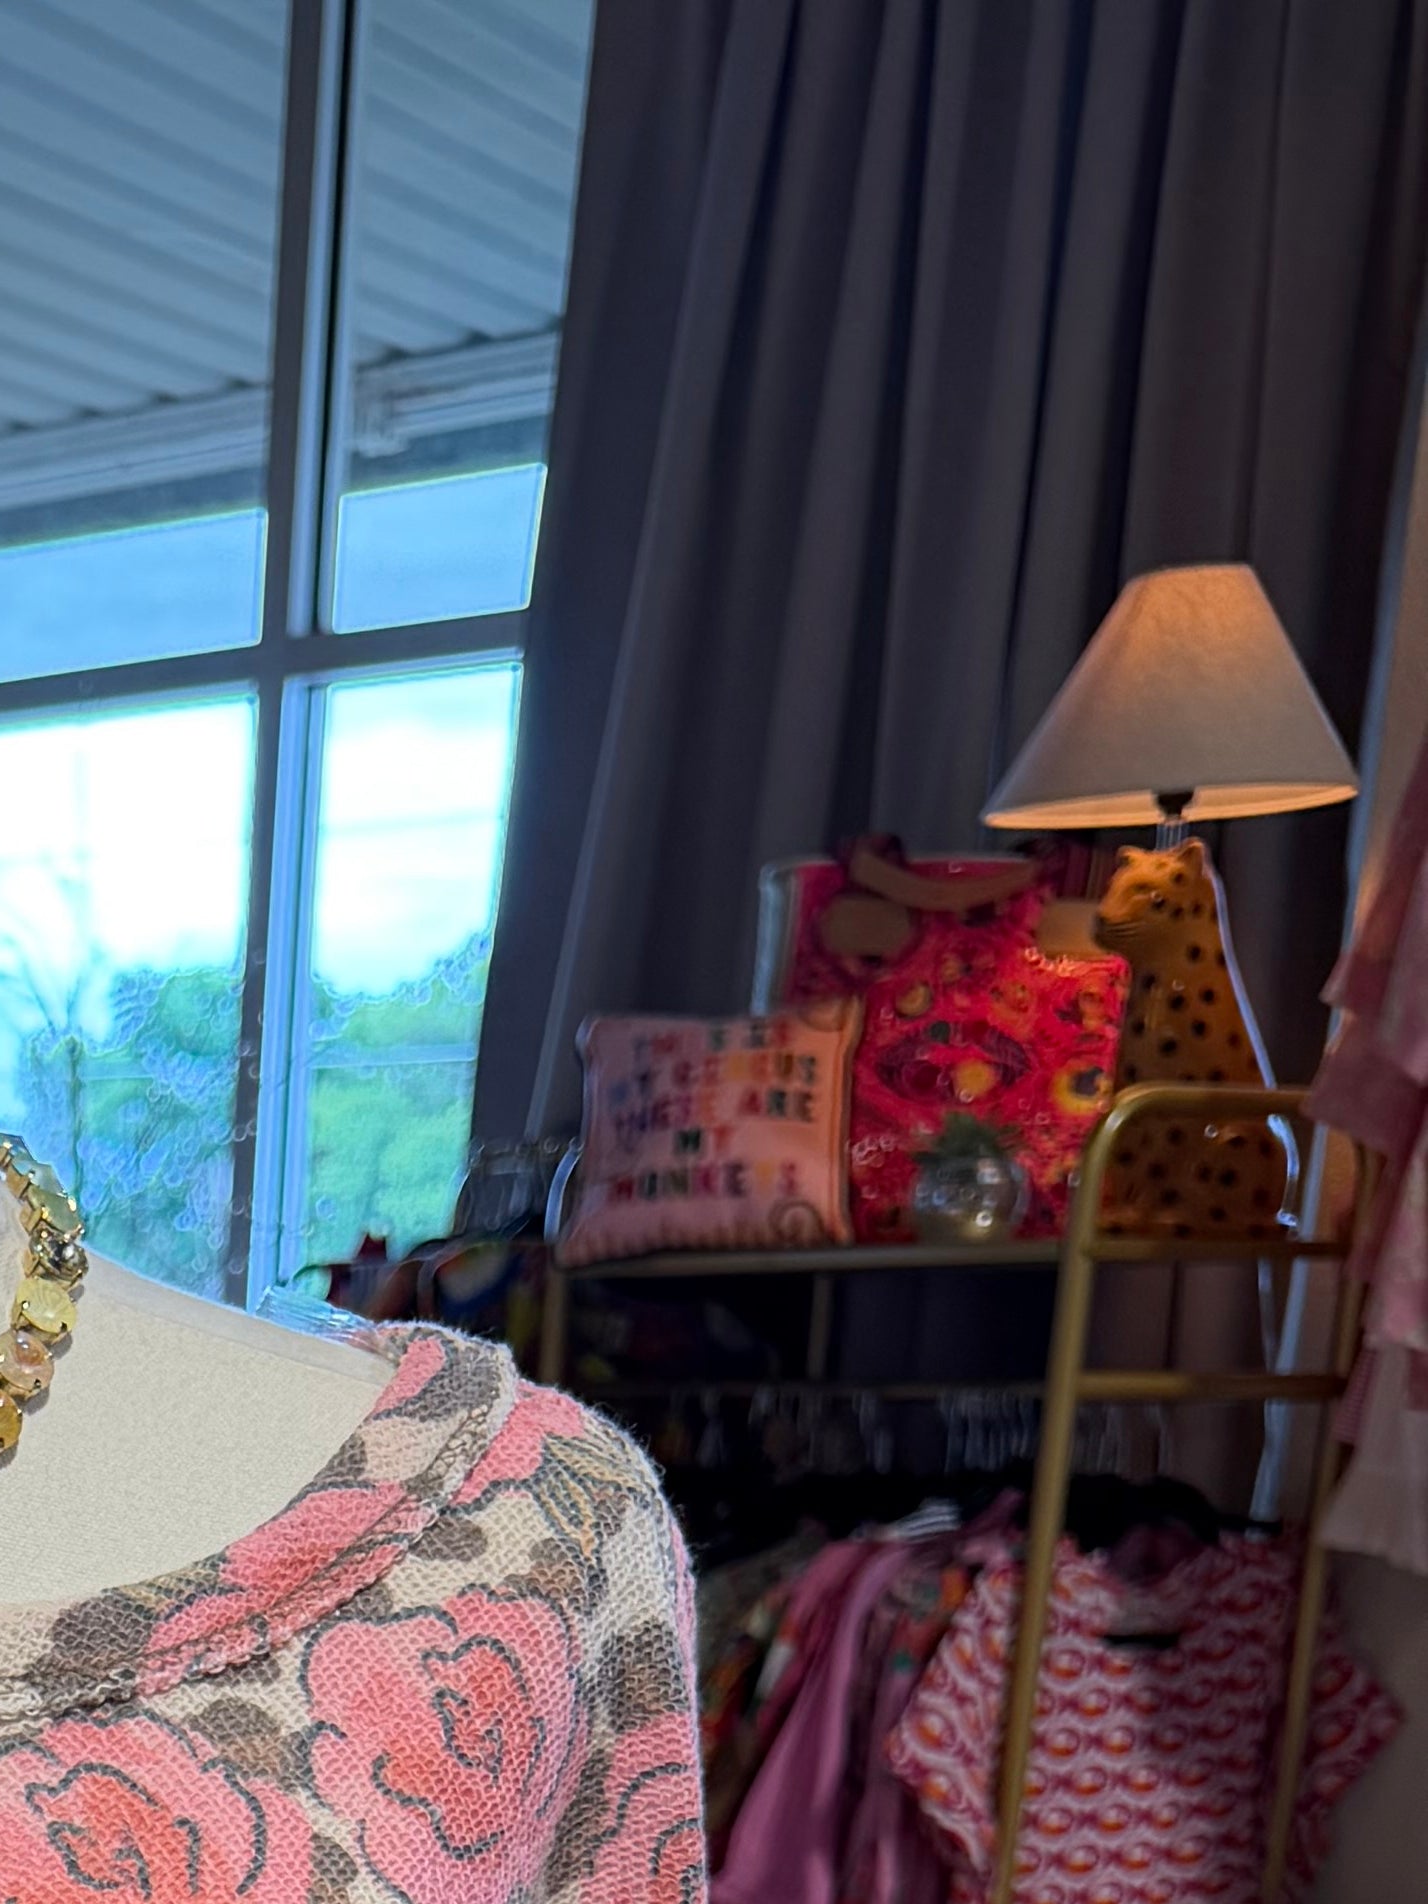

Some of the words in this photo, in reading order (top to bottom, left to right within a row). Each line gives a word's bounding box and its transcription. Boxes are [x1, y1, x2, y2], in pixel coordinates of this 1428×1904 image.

[739, 1087, 815, 1123] ARE
[674, 1126, 734, 1153] MY
[607, 1160, 797, 1203] MONKEYS
